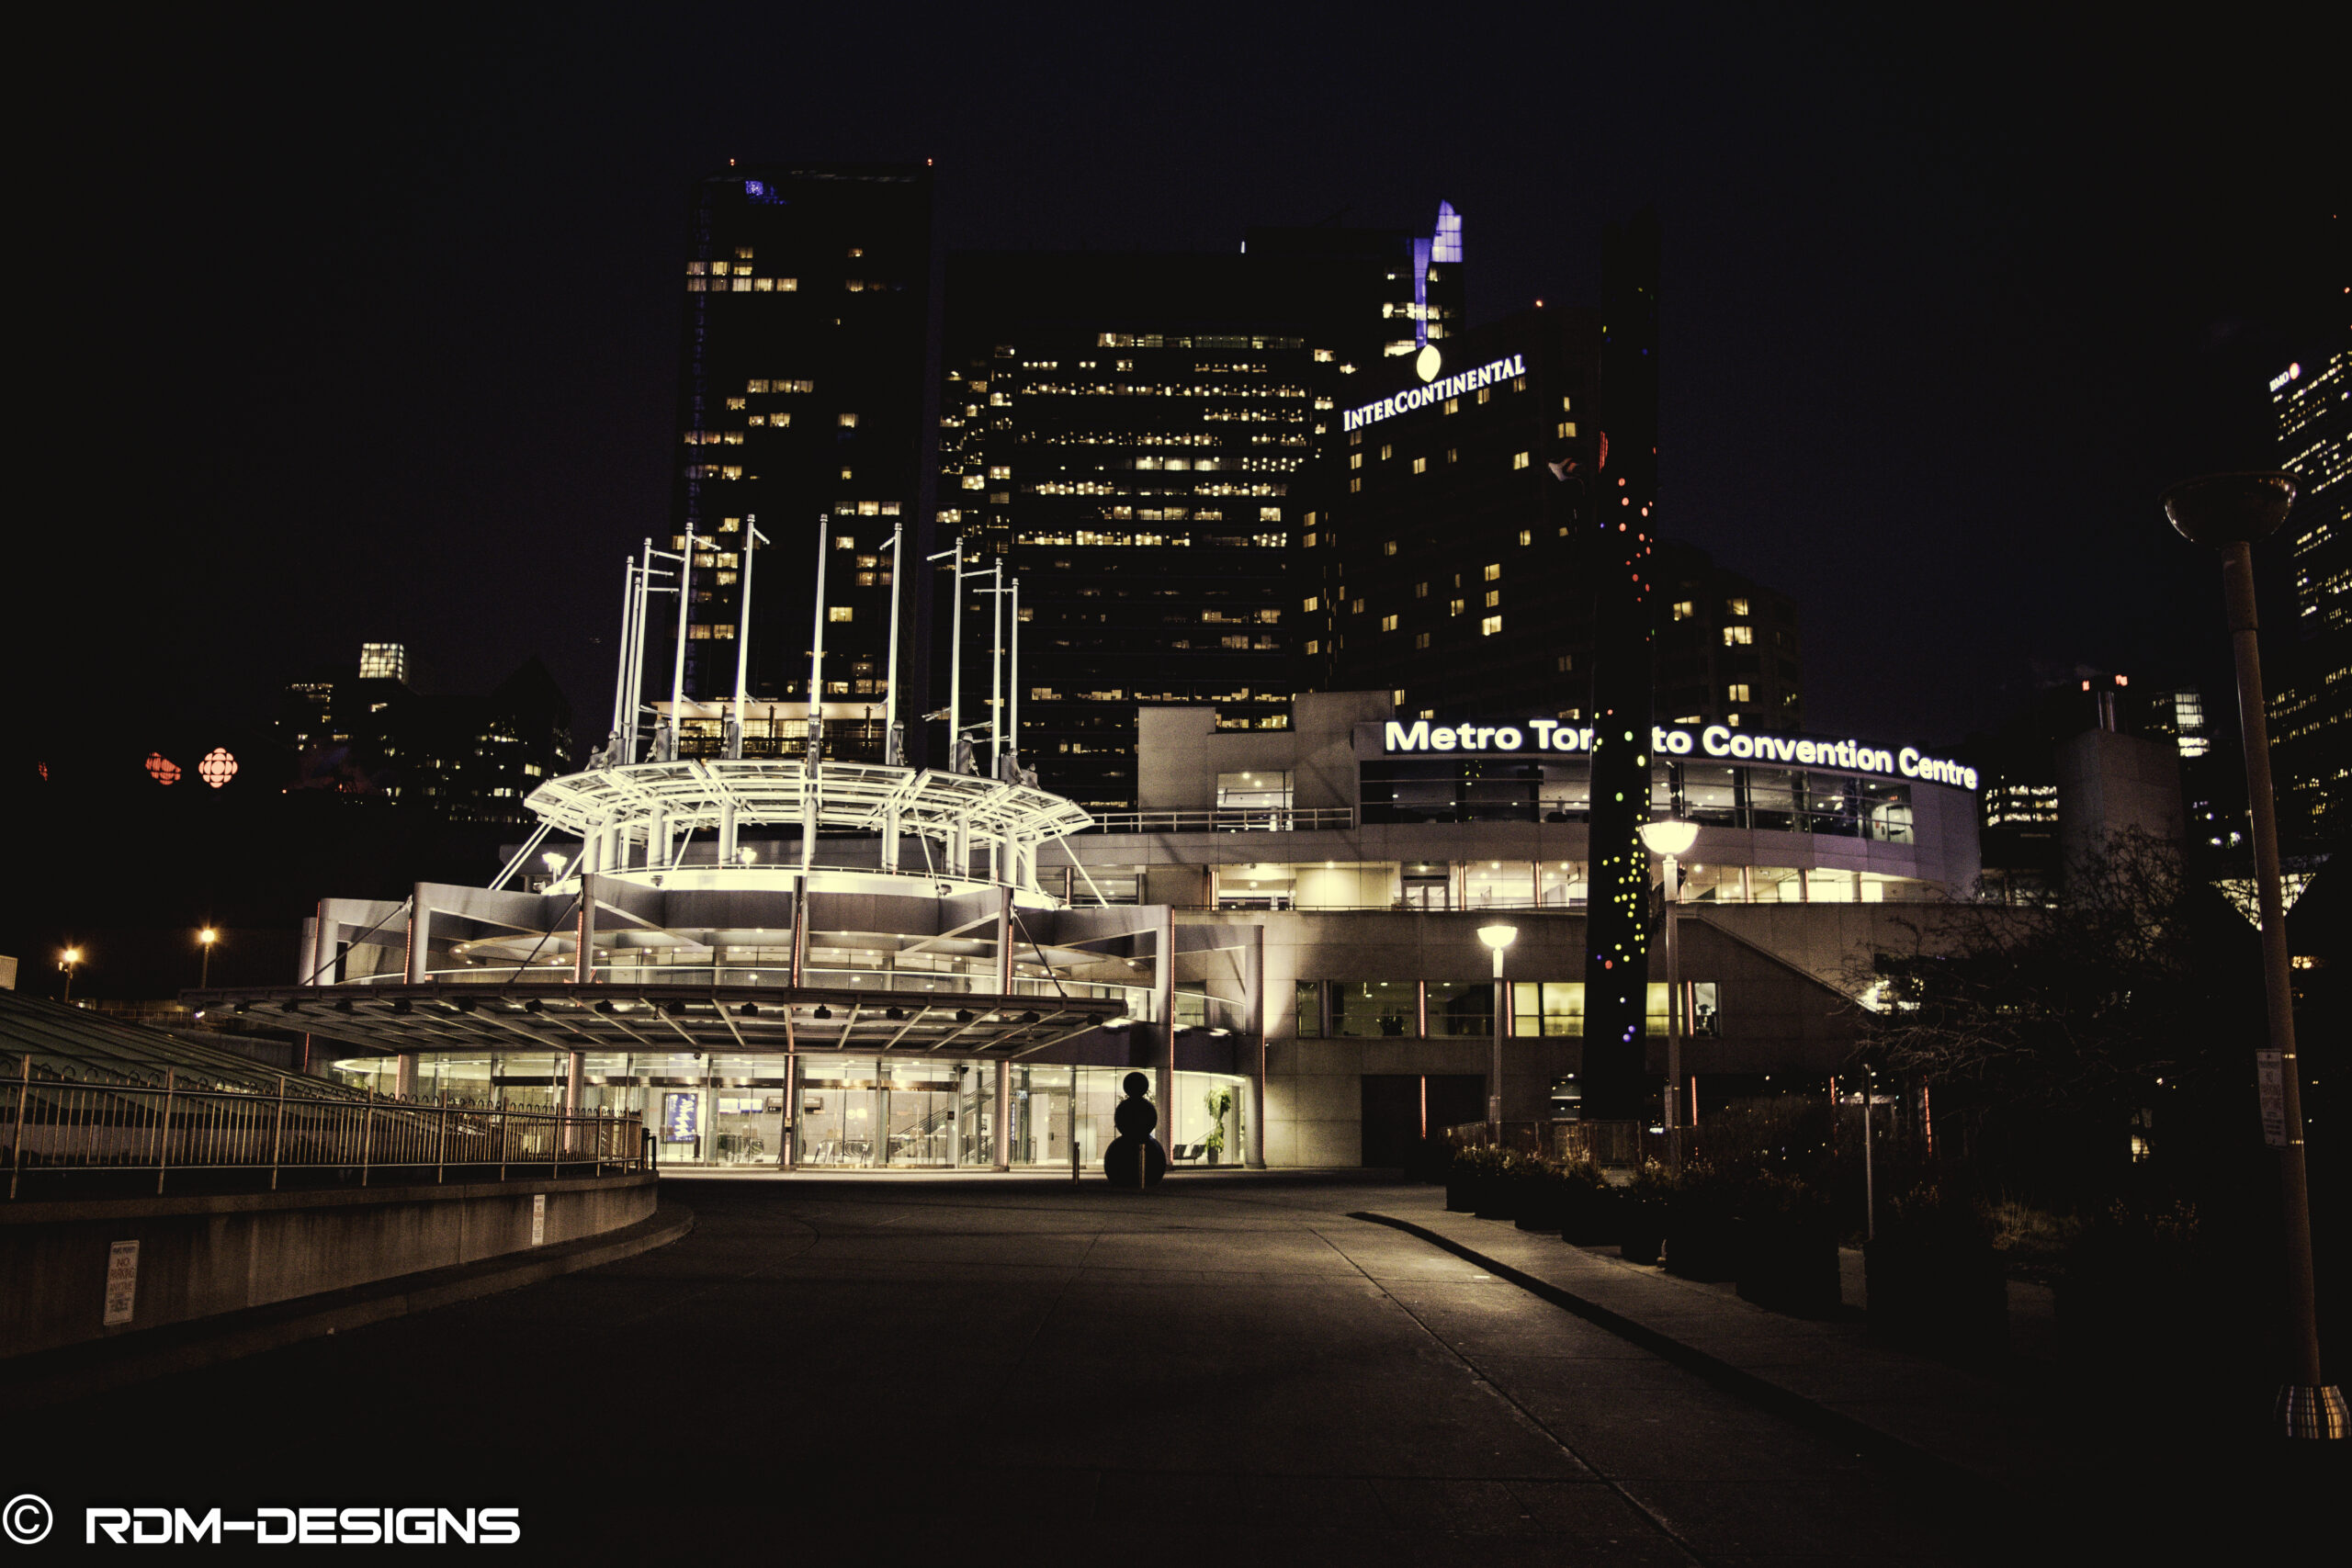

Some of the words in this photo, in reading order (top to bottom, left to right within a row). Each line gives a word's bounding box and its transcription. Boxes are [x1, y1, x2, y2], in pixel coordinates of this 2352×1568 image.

[2269, 370, 2290, 392] BMO
[1385, 720, 1522, 751] Metro
[1529, 720, 1693, 754] Torto
[1702, 725, 1894, 773] Convention
[1898, 747, 1978, 790] Centre
